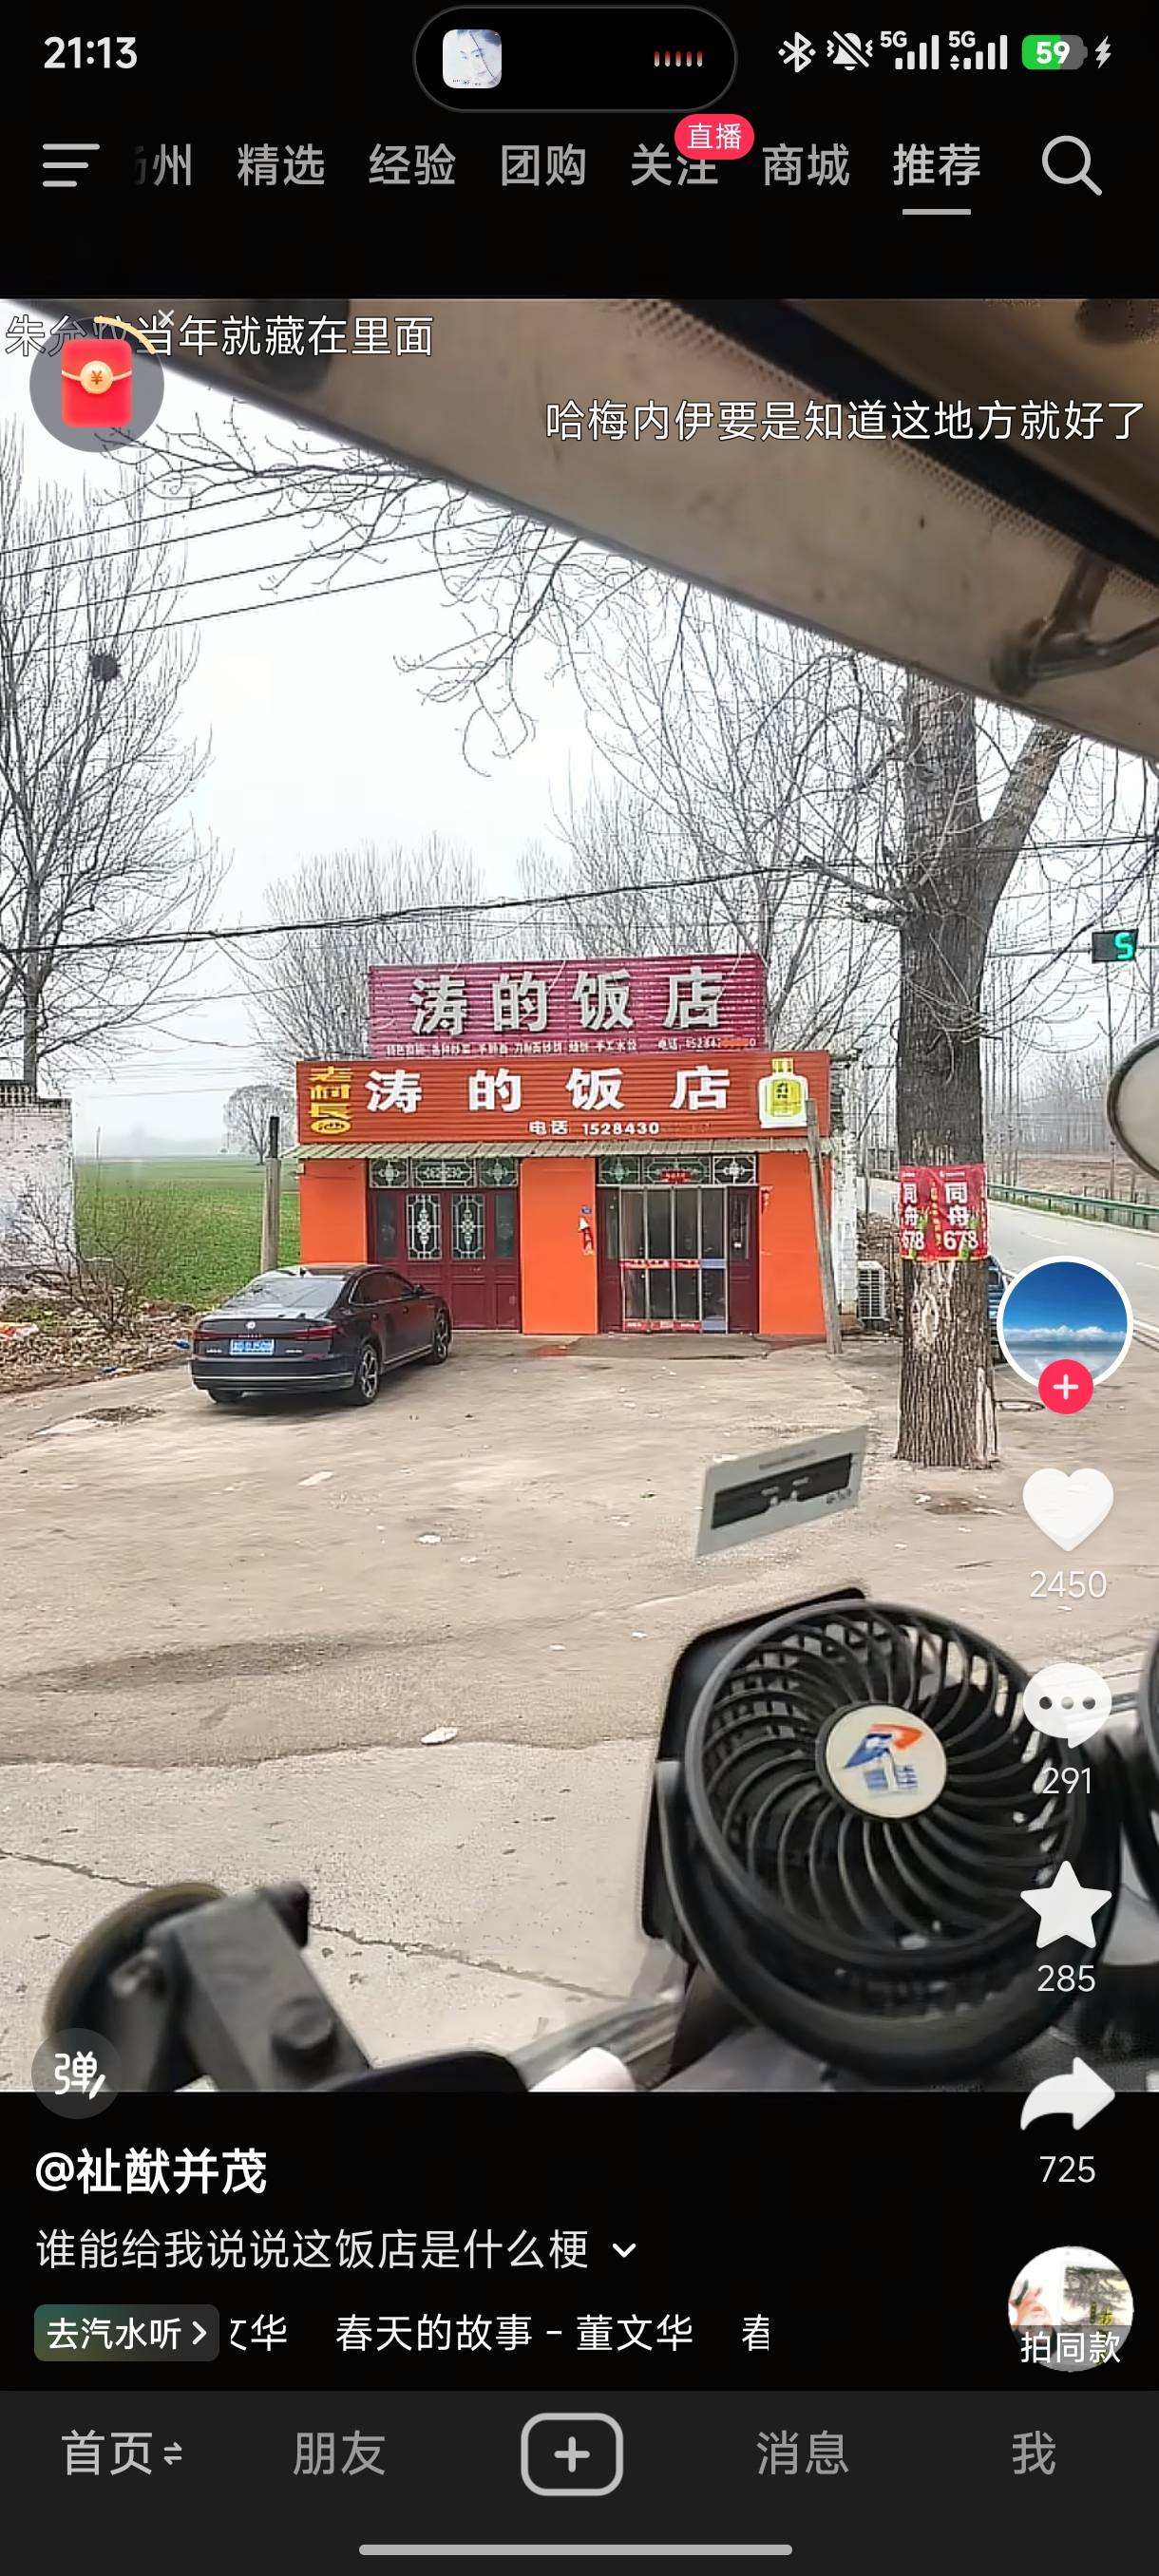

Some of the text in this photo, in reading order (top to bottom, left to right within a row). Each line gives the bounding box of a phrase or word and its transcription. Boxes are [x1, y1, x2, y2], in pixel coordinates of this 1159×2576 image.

[410, 966, 723, 1036] 涛的饭店
[364, 1065, 731, 1114] 涛的饭店
[528, 1120, 660, 1136] 电话 1528430
[942, 1230, 978, 1251] 678
